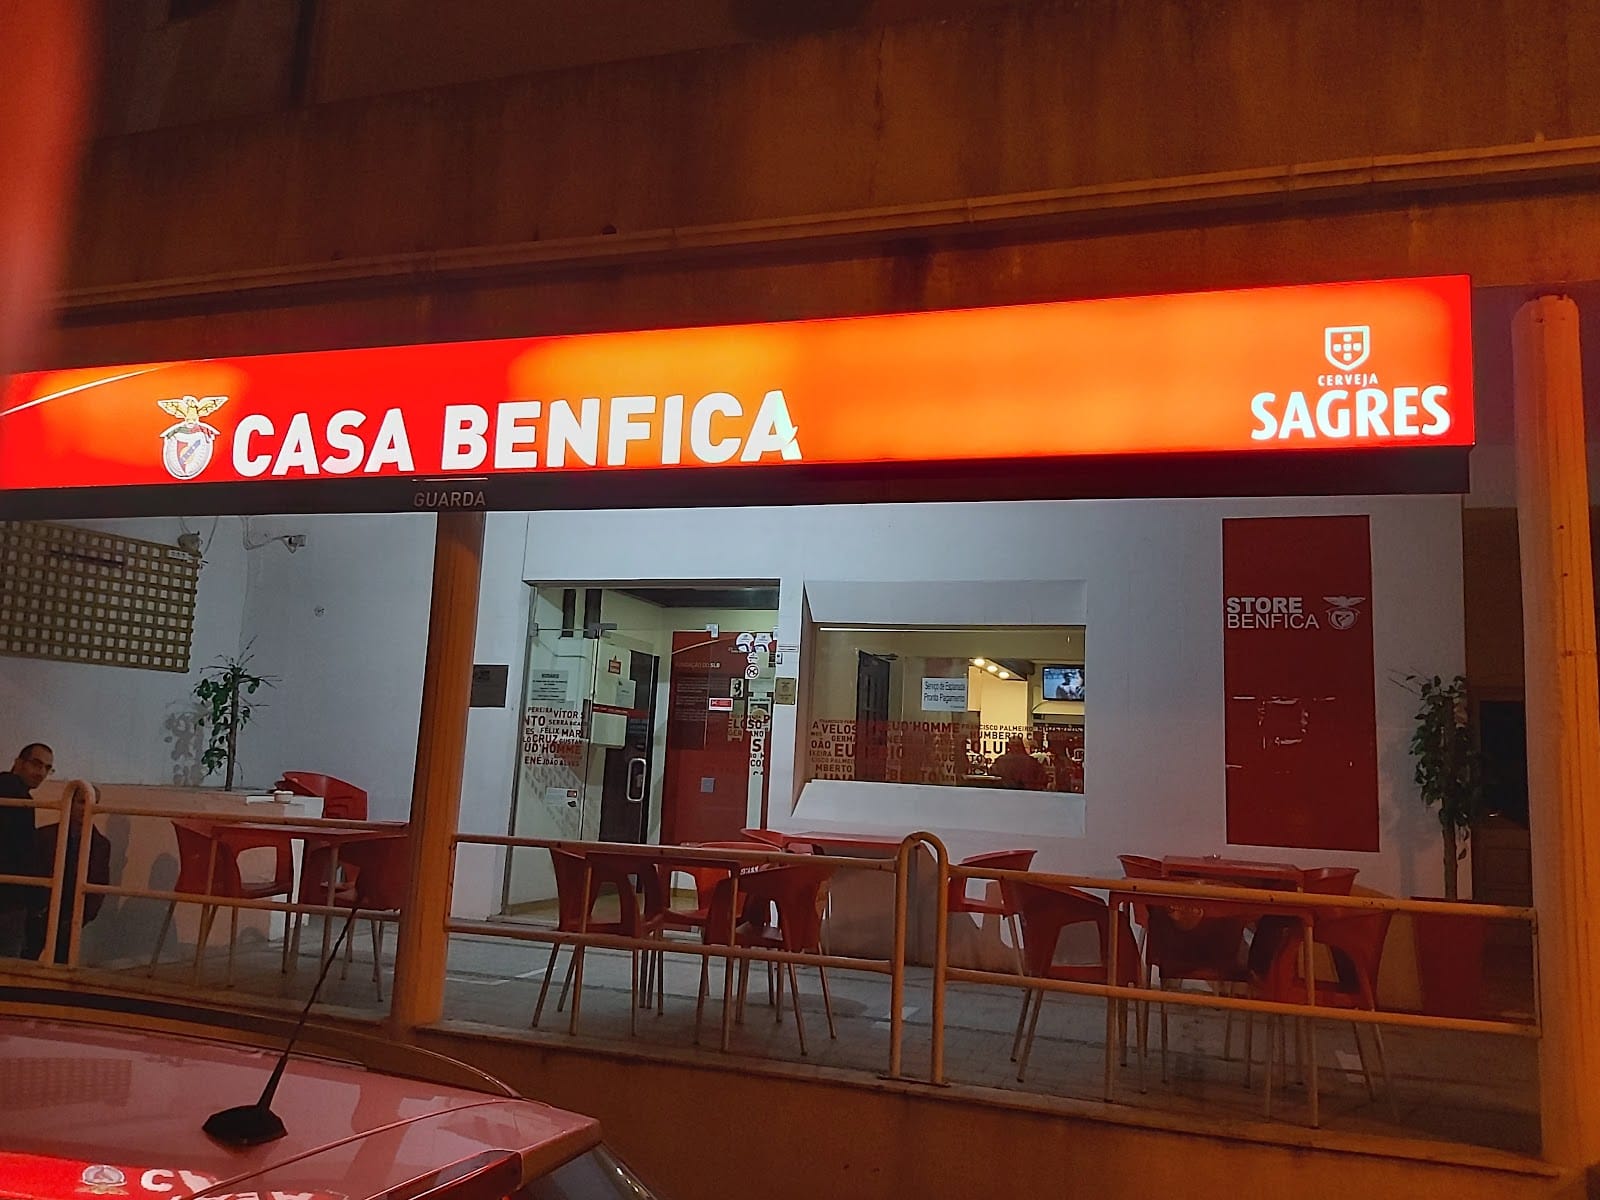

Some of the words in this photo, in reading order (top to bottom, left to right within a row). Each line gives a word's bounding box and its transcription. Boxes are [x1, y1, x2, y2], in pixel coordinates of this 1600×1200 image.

[1318, 373, 1378, 386] CERVEJA
[1251, 385, 1451, 440] SAGRES
[232, 408, 415, 477] CASA
[441, 390, 803, 470] BENFICA
[413, 490, 486, 507] GUARDA
[1226, 597, 1303, 613] STORE
[1227, 613, 1320, 629] BENFICA
[553, 708, 578, 719] VÍTOR
[532, 734, 558, 744] CRUZ
